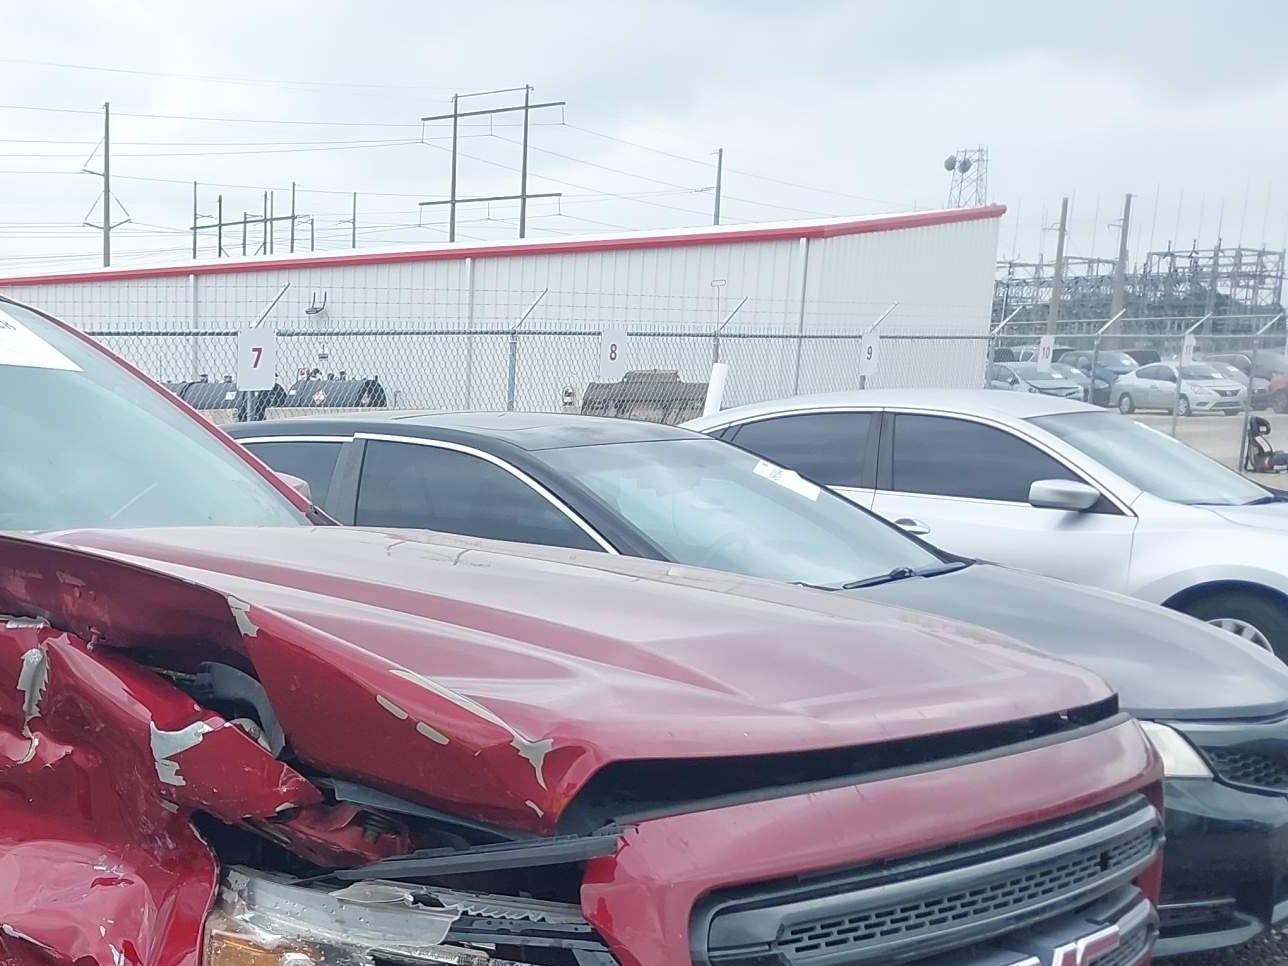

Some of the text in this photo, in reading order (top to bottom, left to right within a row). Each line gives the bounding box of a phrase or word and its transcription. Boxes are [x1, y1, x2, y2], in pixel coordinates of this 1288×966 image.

[251, 347, 263, 369] 7
[609, 343, 618, 361] 8
[866, 345, 873, 361] 9
